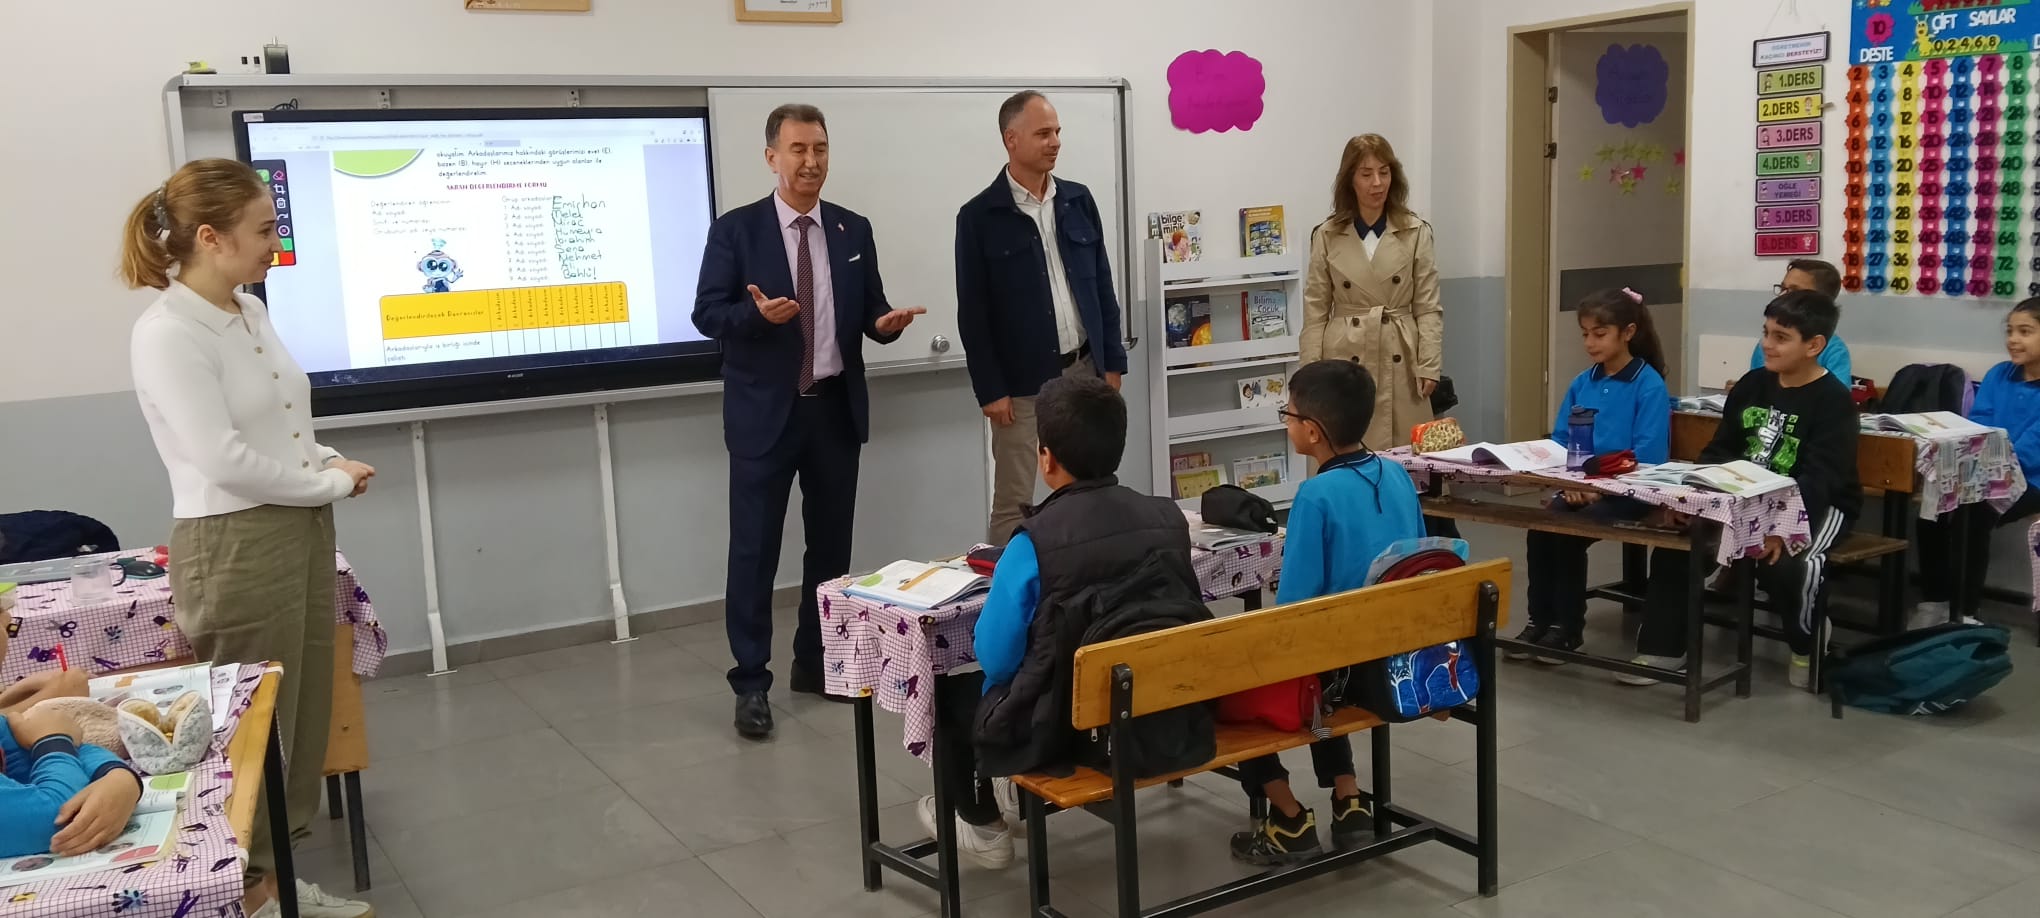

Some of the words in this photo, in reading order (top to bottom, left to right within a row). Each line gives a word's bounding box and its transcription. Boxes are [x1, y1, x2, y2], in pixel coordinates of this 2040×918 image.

[1932, 13, 1958, 34] ÇİFT
[1968, 7, 2017, 27] SAYILAR
[1872, 21, 1886, 35] 10
[1934, 40, 1943, 52] 0
[1948, 39, 1956, 51] 2
[1960, 38, 1970, 49] 4
[1974, 37, 1983, 48] 6
[1988, 36, 1996, 47] 8
[1860, 46, 1894, 62] DESTE
[2013, 56, 2023, 70] 8
[1878, 65, 1888, 79] 3
[1903, 64, 1914, 77] 4
[1779, 71, 1815, 87] 1.DERS
[1903, 87, 1912, 101] 8
[2012, 80, 2025, 95] 16
[1877, 89, 1887, 102] 6
[1762, 100, 1800, 117] 2.DERS
[2008, 106, 2025, 119] 24
[1877, 113, 1887, 127] 9
[1900, 112, 1912, 125] 12
[1776, 127, 1814, 142] 3.DERS
[2005, 131, 2023, 145] 32
[1874, 136, 1887, 149] 12
[1899, 135, 1912, 148] 16
[1762, 156, 1800, 170] 4.DERS
[1872, 160, 1885, 173] 15
[1897, 159, 1913, 172] 20
[2001, 156, 2022, 170] 40
[1873, 183, 1886, 197] 18
[1896, 183, 1911, 196] 24
[2001, 181, 2020, 195] 48
[1161, 214, 1182, 225] bilge
[1775, 209, 1812, 224] 5.DERS
[1872, 207, 1884, 220] 21
[1896, 207, 1910, 220] 28
[2001, 207, 2018, 220] 56
[1870, 230, 1886, 243] 24
[1894, 230, 1909, 243] 32
[1998, 232, 2016, 245] 64
[1869, 253, 1884, 266] 27
[1894, 253, 1908, 266] 36
[1997, 256, 2013, 270] 72
[1867, 276, 1884, 289] 30
[1891, 277, 1909, 290] 40
[1995, 281, 2014, 295] 80
